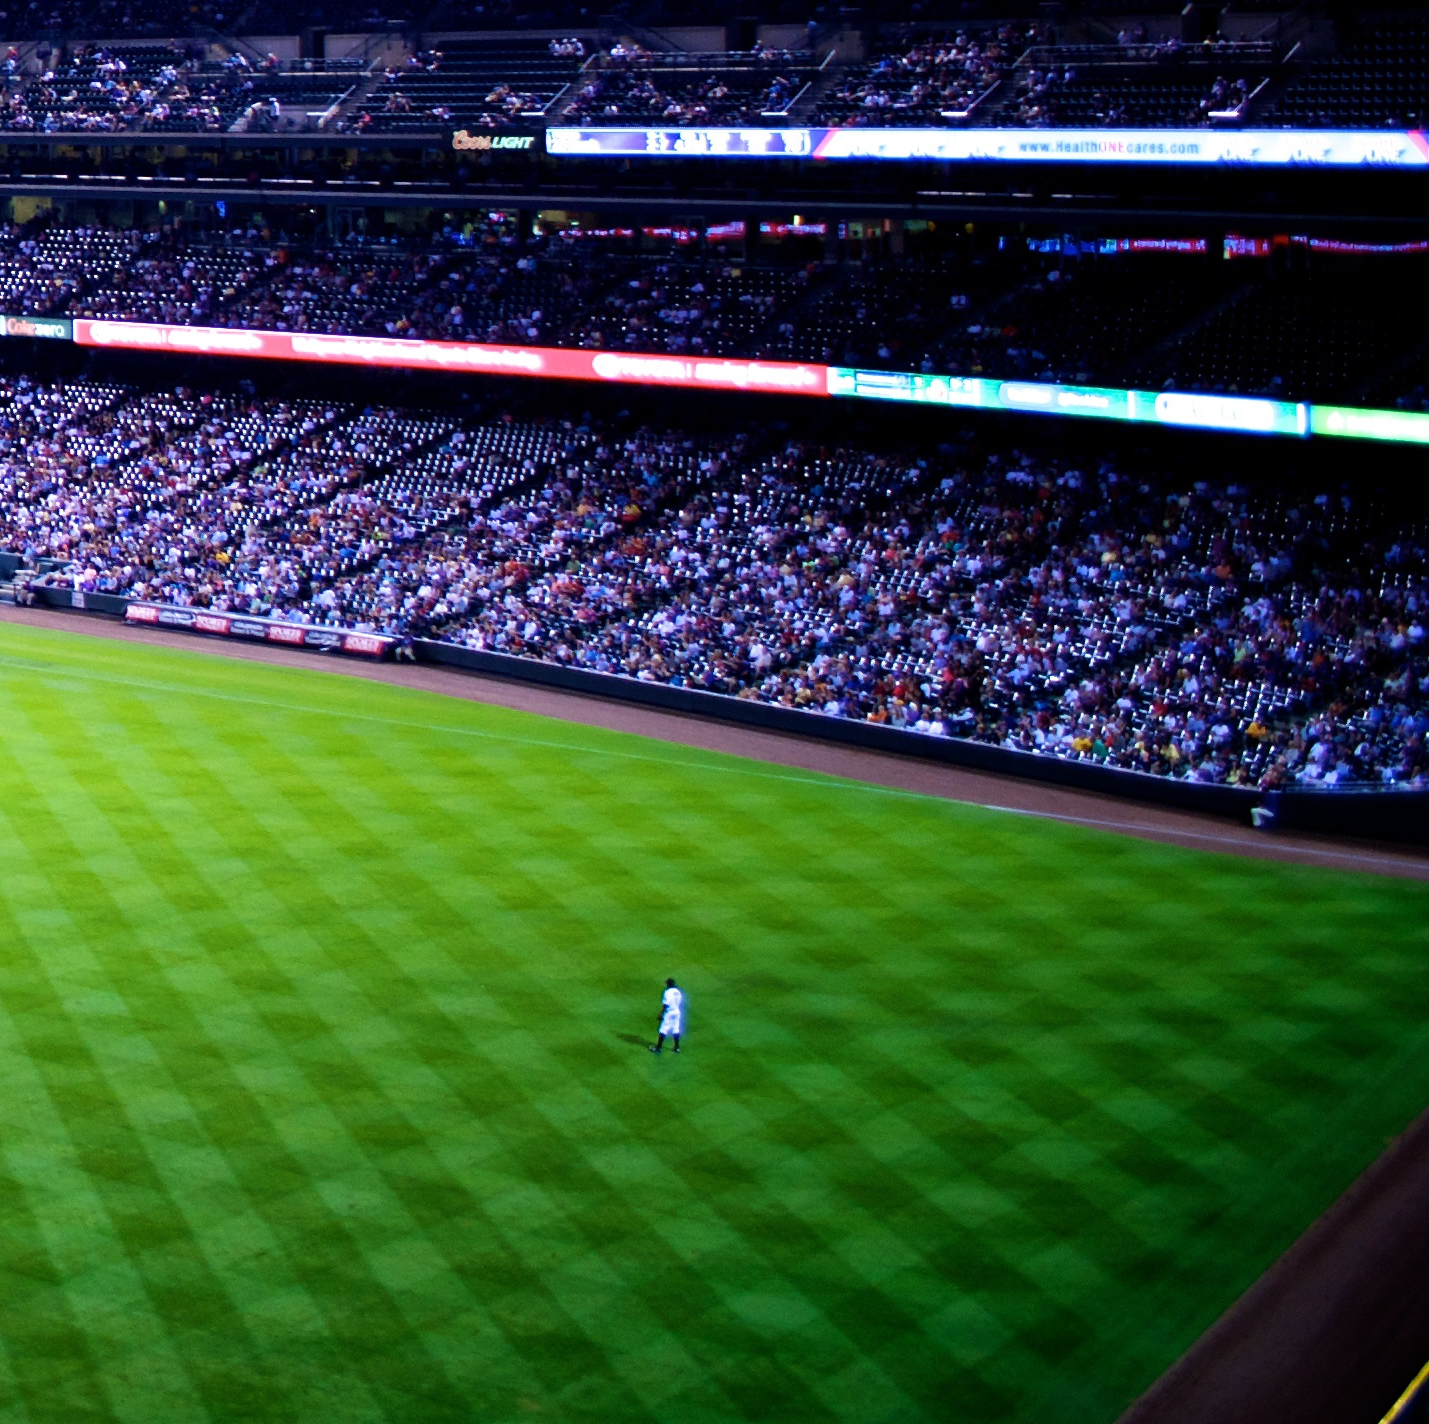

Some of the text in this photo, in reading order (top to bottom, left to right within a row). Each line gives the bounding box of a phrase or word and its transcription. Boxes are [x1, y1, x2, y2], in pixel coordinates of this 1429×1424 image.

[491, 137, 535, 149] LIGHT
[1018, 140, 1200, 154] www.HealthONEcares.com
[7, 318, 64, 337] Coke zero
